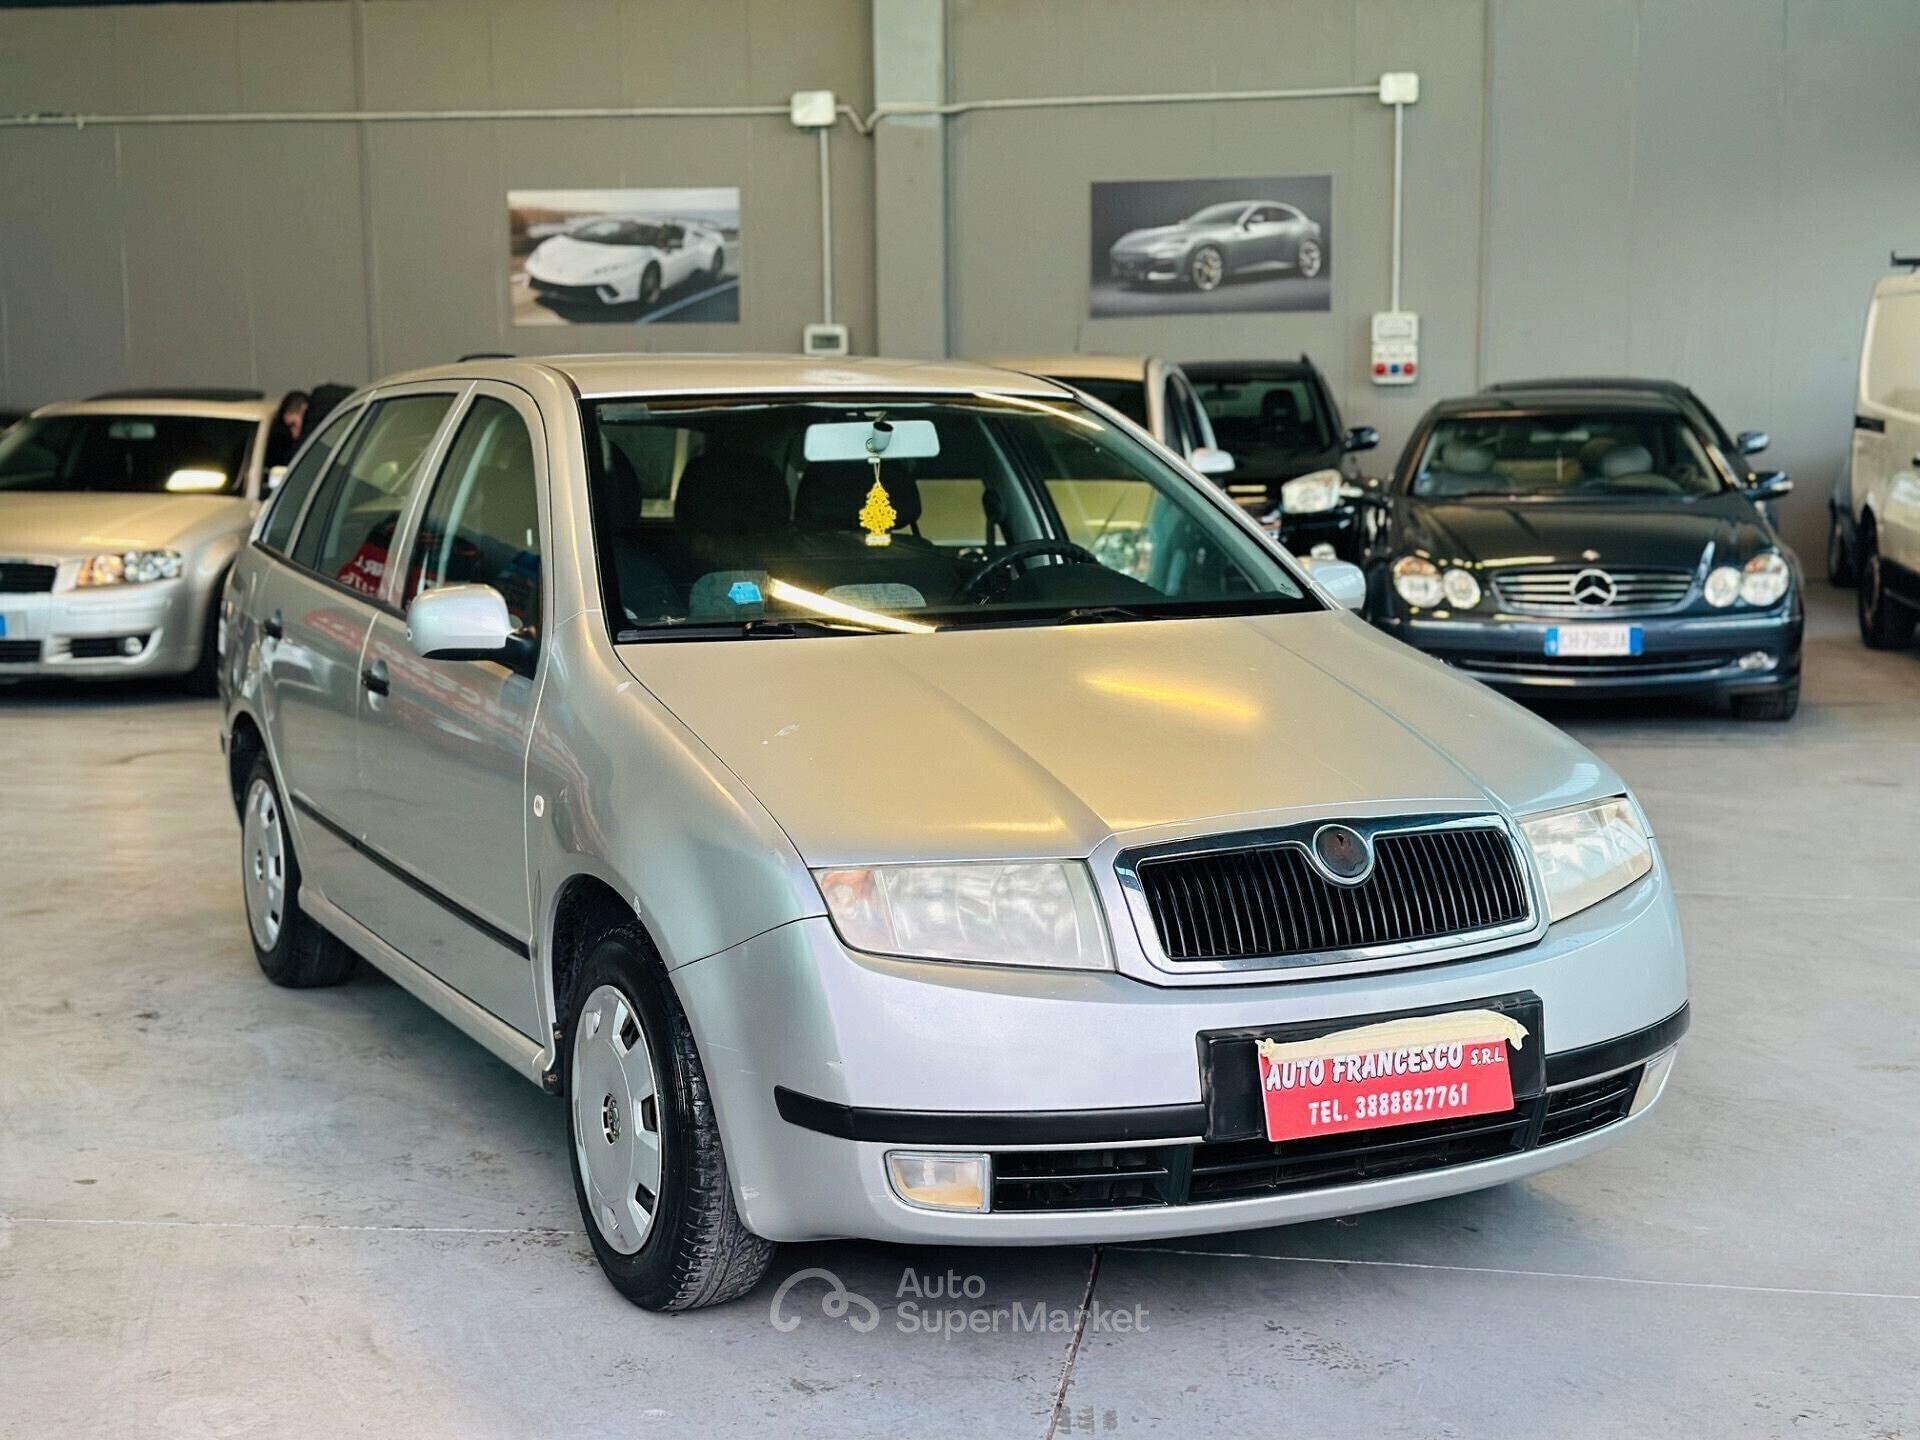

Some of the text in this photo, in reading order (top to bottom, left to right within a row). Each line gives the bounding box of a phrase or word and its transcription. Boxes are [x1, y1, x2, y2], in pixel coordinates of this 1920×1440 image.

[1266, 1059, 1325, 1091] AUTO
[1331, 1042, 1463, 1083] FRANCESCO
[1307, 1083, 1469, 1126] TEL. 3888827761
